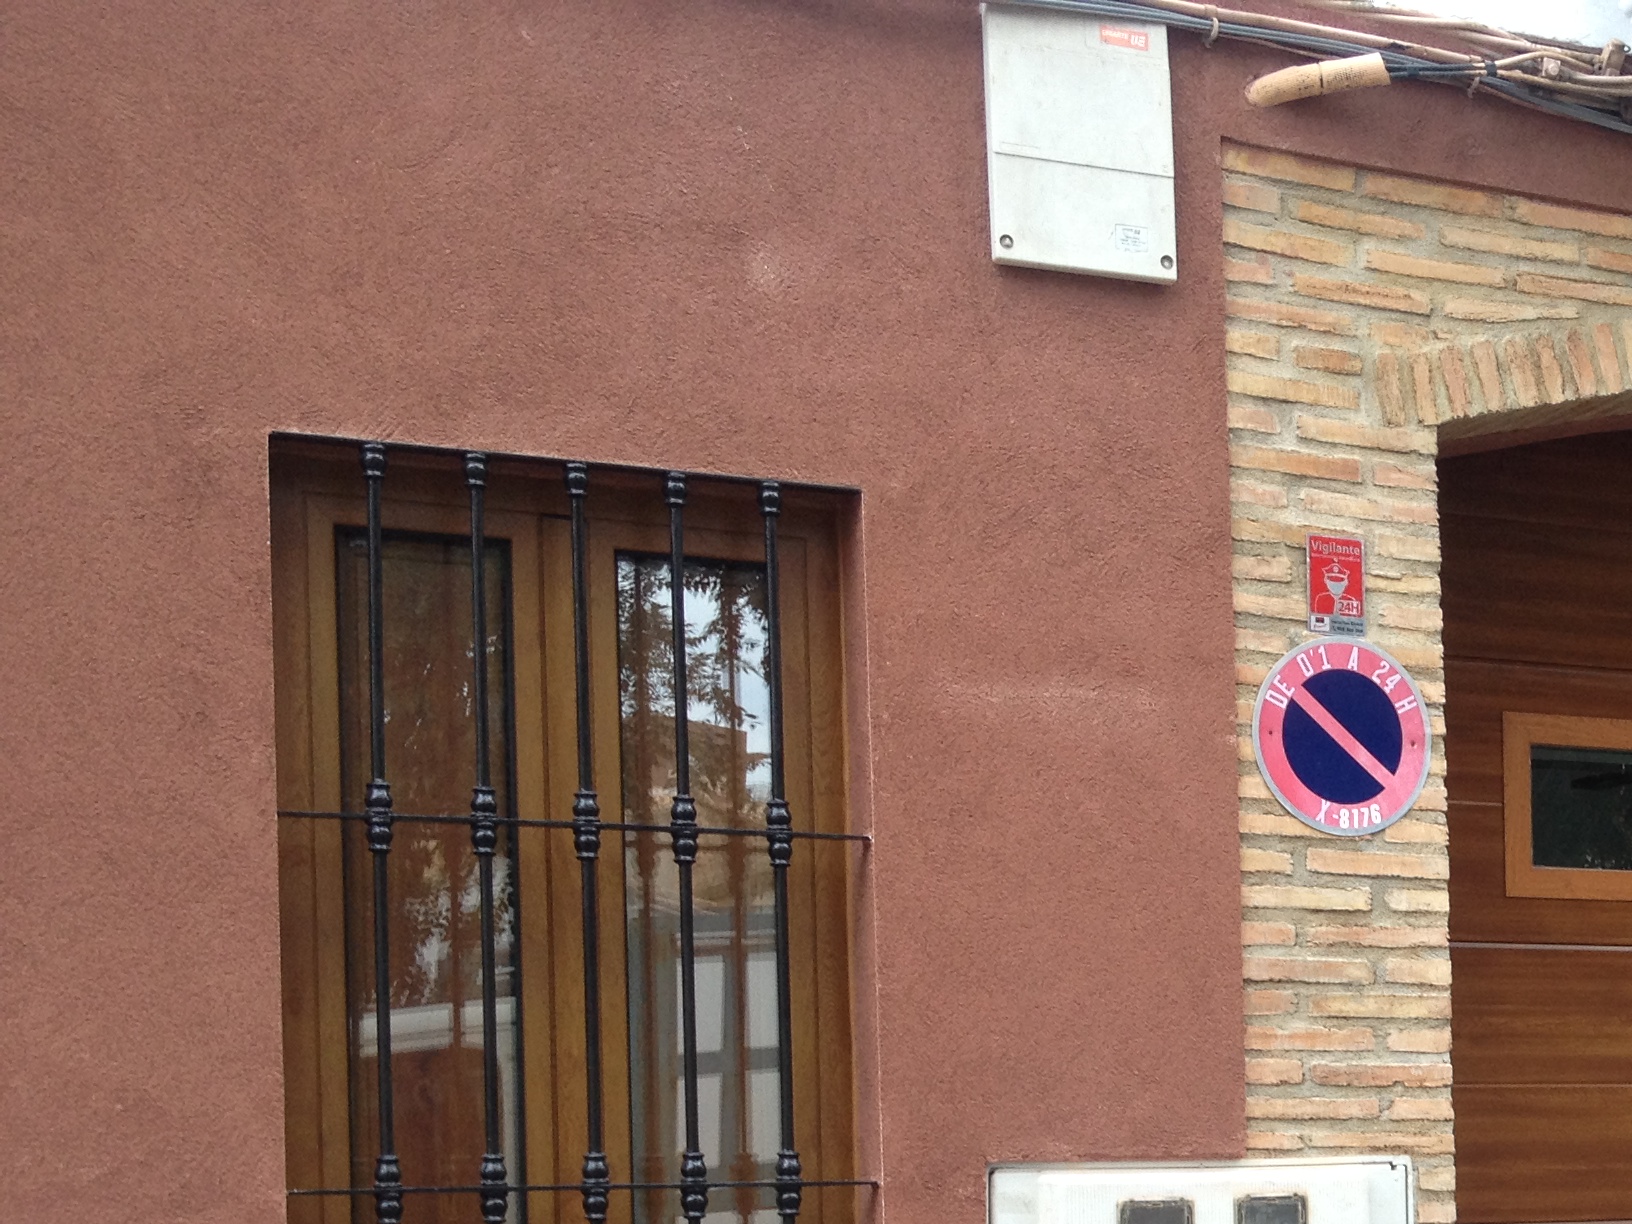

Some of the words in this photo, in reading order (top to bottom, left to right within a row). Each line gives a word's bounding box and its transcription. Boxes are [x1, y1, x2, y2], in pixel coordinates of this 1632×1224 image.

[1311, 539, 1360, 556] Vigilante
[1338, 601, 1360, 614] 24H
[1265, 674, 1296, 709] DE
[1347, 646, 1360, 671] A
[1371, 660, 1402, 693] 24
[1394, 695, 1418, 714] H
